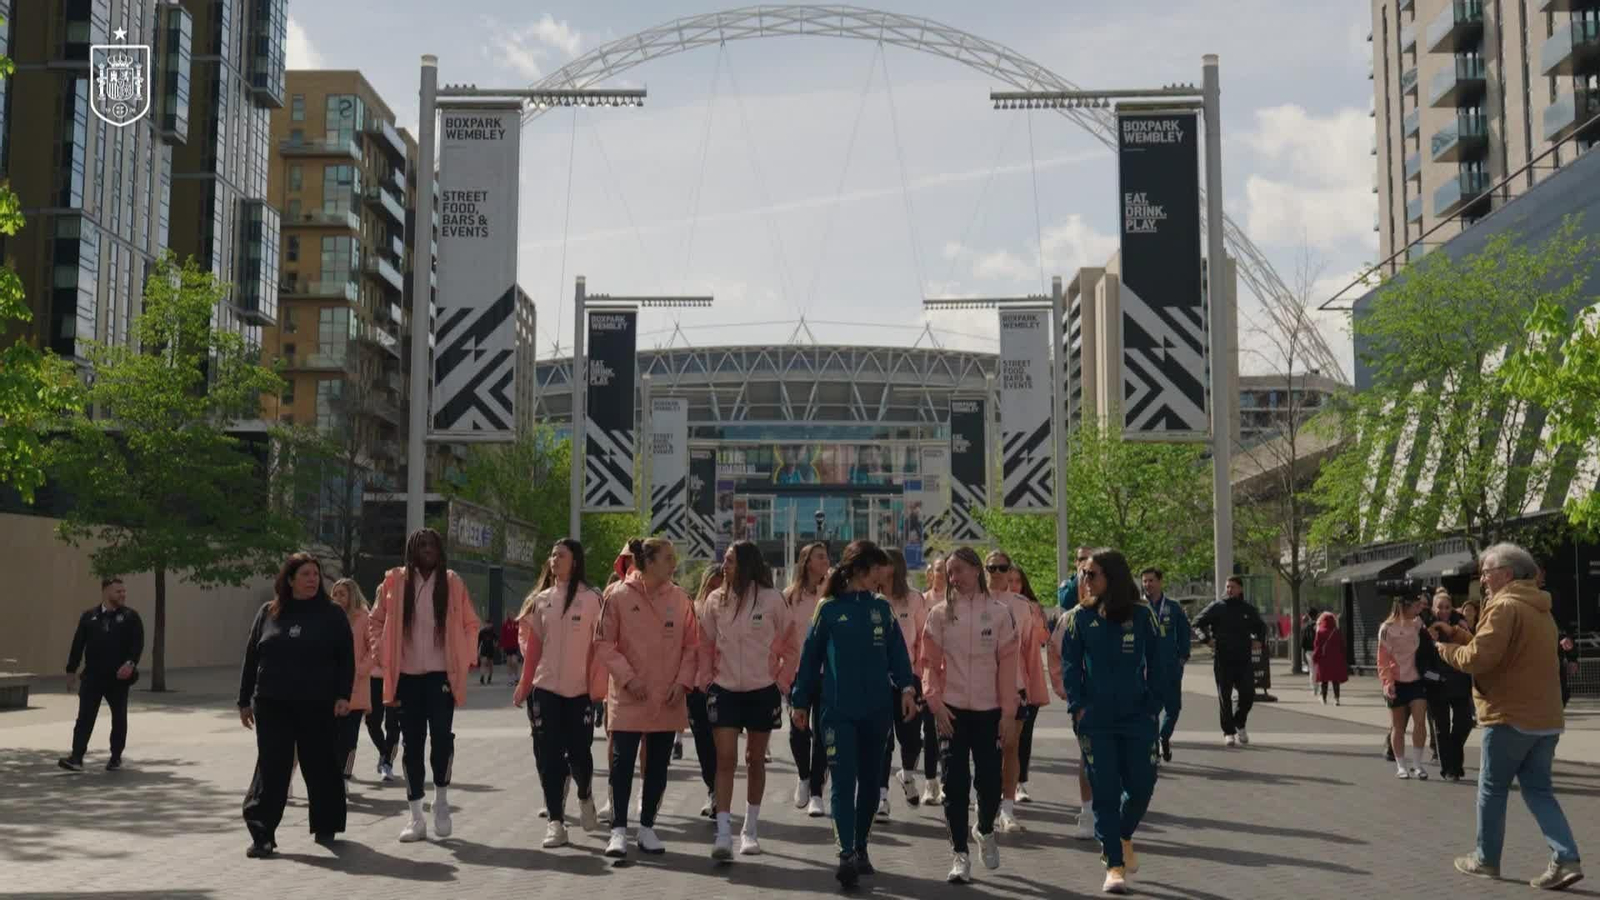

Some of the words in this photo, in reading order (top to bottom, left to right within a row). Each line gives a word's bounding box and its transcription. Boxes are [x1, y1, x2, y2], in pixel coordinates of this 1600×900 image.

[445, 118, 502, 128] BOXPARK
[1123, 120, 1180, 132] BOXPARK
[446, 129, 506, 140] WEMBLEY
[1124, 131, 1184, 143] WEMBLEY
[442, 191, 488, 202] STREET
[442, 203, 479, 214] FOOD,
[1125, 206, 1167, 217] DRINK.
[442, 215, 475, 225] BARS
[478, 215, 488, 225] &
[442, 226, 489, 237] EVENTS
